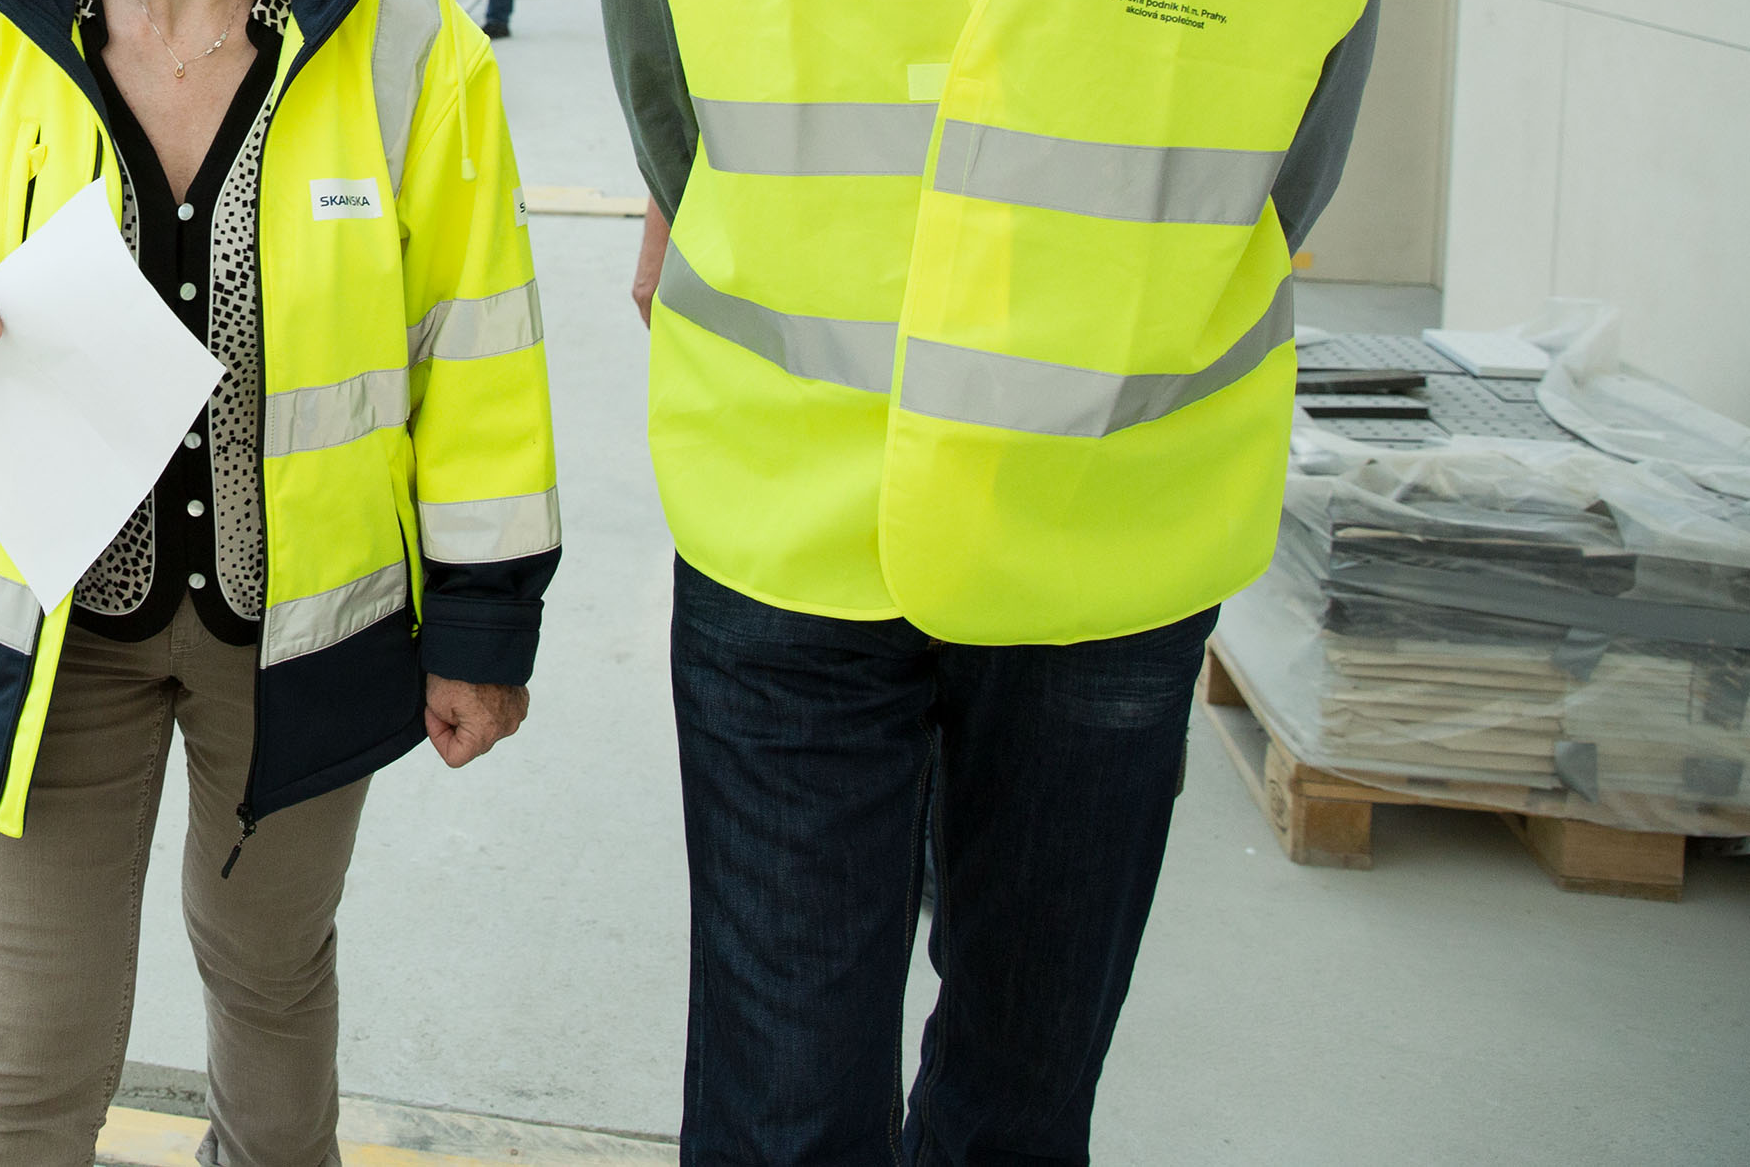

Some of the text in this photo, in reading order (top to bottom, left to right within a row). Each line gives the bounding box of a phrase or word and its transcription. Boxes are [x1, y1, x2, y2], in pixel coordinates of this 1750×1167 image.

[1126, 5, 1158, 19] akciová
[1200, 9, 1227, 24] Prahy,
[319, 195, 370, 207] SKANSKA
